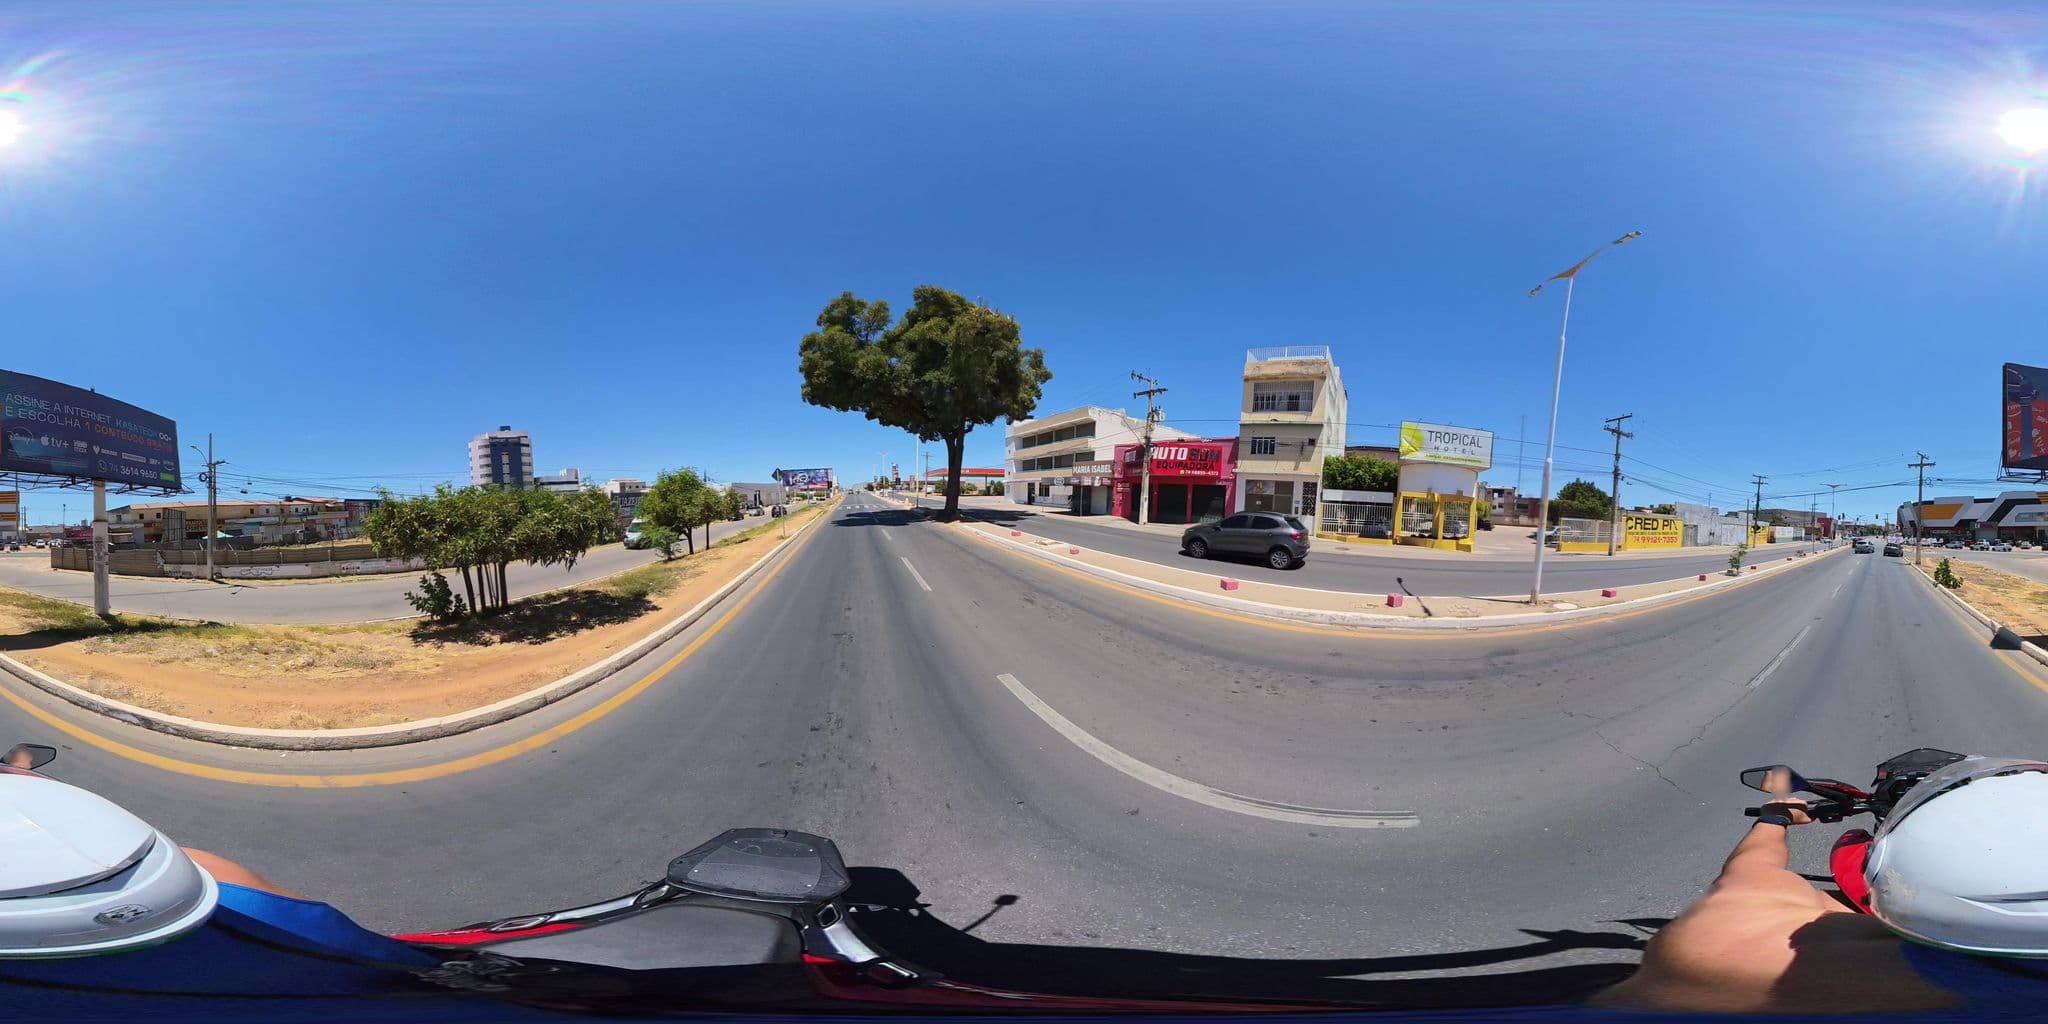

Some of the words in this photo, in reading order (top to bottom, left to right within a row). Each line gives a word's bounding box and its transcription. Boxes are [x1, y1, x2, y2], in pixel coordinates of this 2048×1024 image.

[5, 393, 50, 411] ASSINE
[54, 402, 62, 413] A
[64, 405, 111, 425] INTERNET
[5, 406, 13, 417] E
[18, 408, 81, 429] ESCOLHA
[1427, 430, 1483, 449] TROPICAL
[1150, 446, 1189, 461] AUTO
[1434, 445, 1475, 456] HOTEL
[1072, 465, 1091, 474] MARIA
[1091, 464, 1112, 473] ISABEL
[1156, 460, 1215, 471] EQUIPADORA
[1625, 517, 1659, 531] CRED
